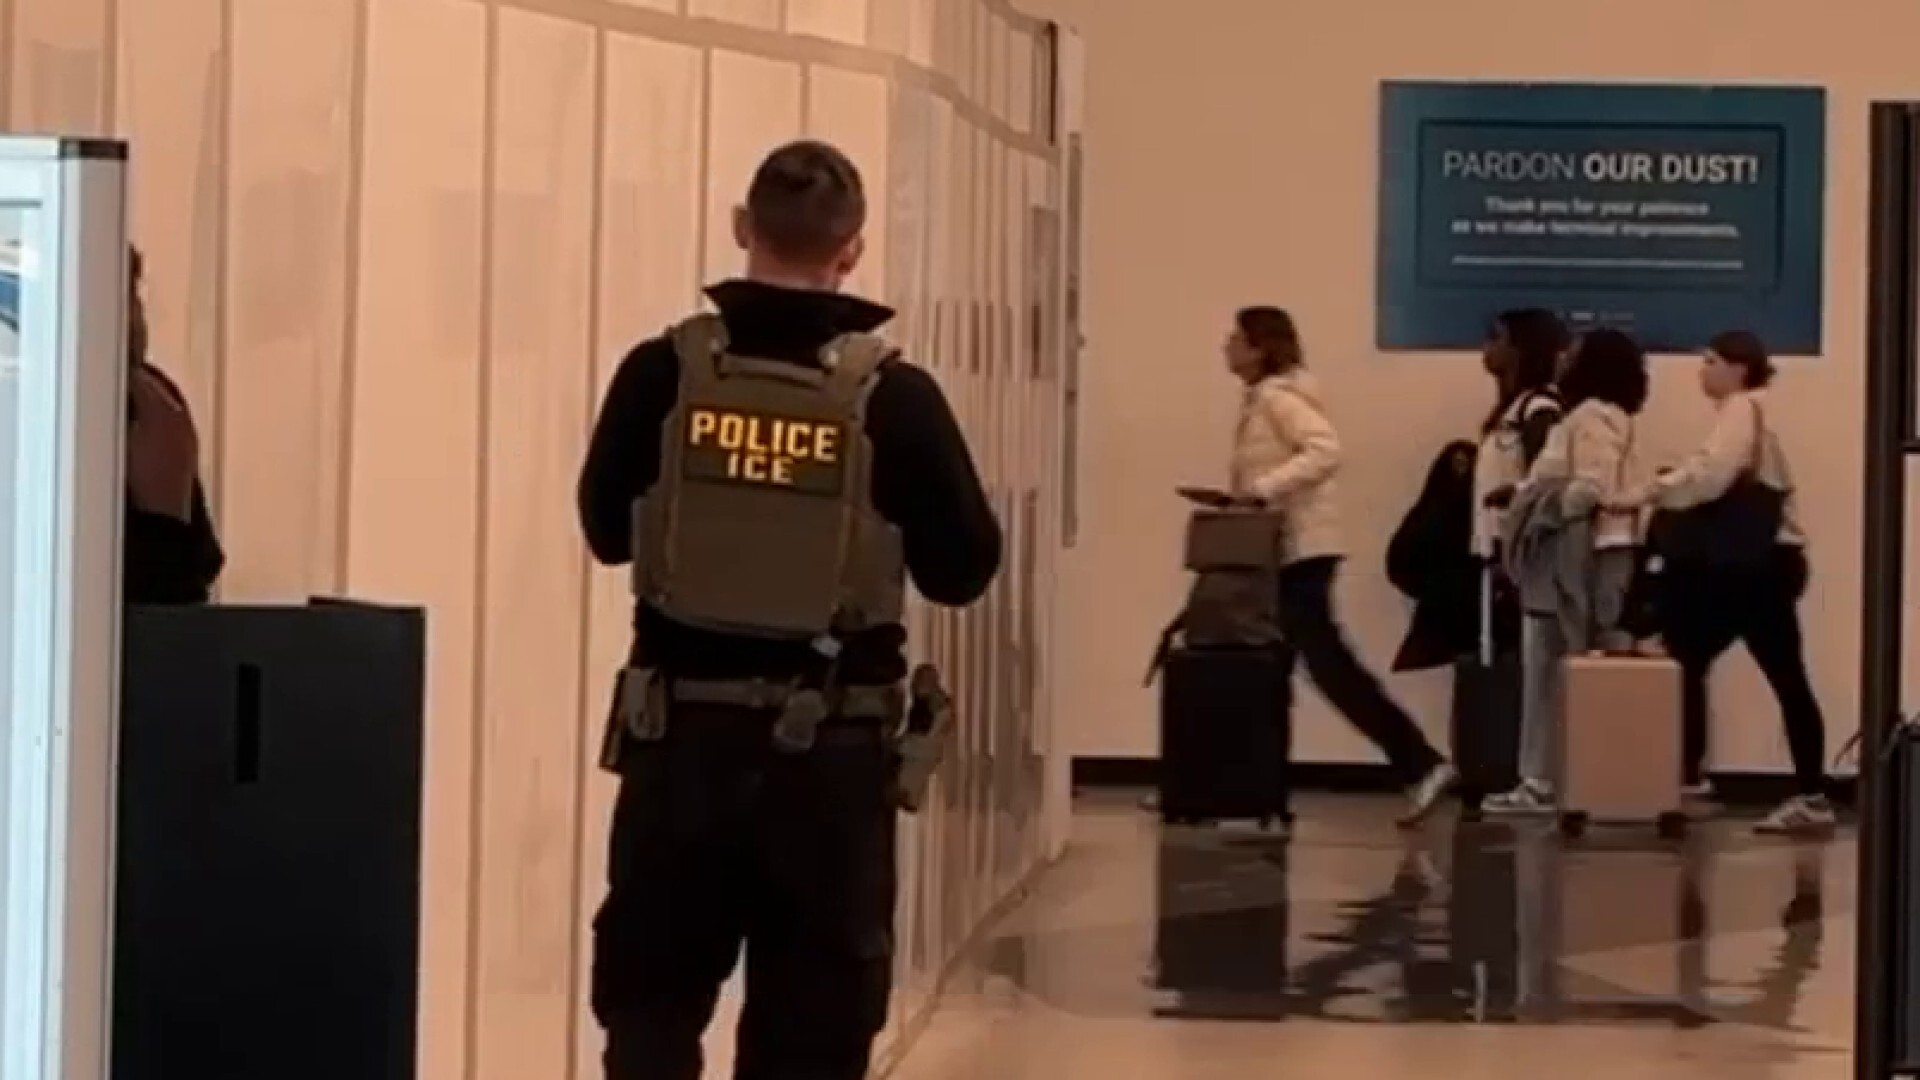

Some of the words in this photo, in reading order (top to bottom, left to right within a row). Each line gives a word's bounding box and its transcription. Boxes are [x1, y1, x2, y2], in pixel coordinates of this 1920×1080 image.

[1444, 151, 1575, 180] PARDON
[1583, 152, 1653, 182] OUR
[1661, 153, 1758, 185] DUST!
[689, 410, 838, 462] POLICE
[727, 452, 795, 485] ICE
